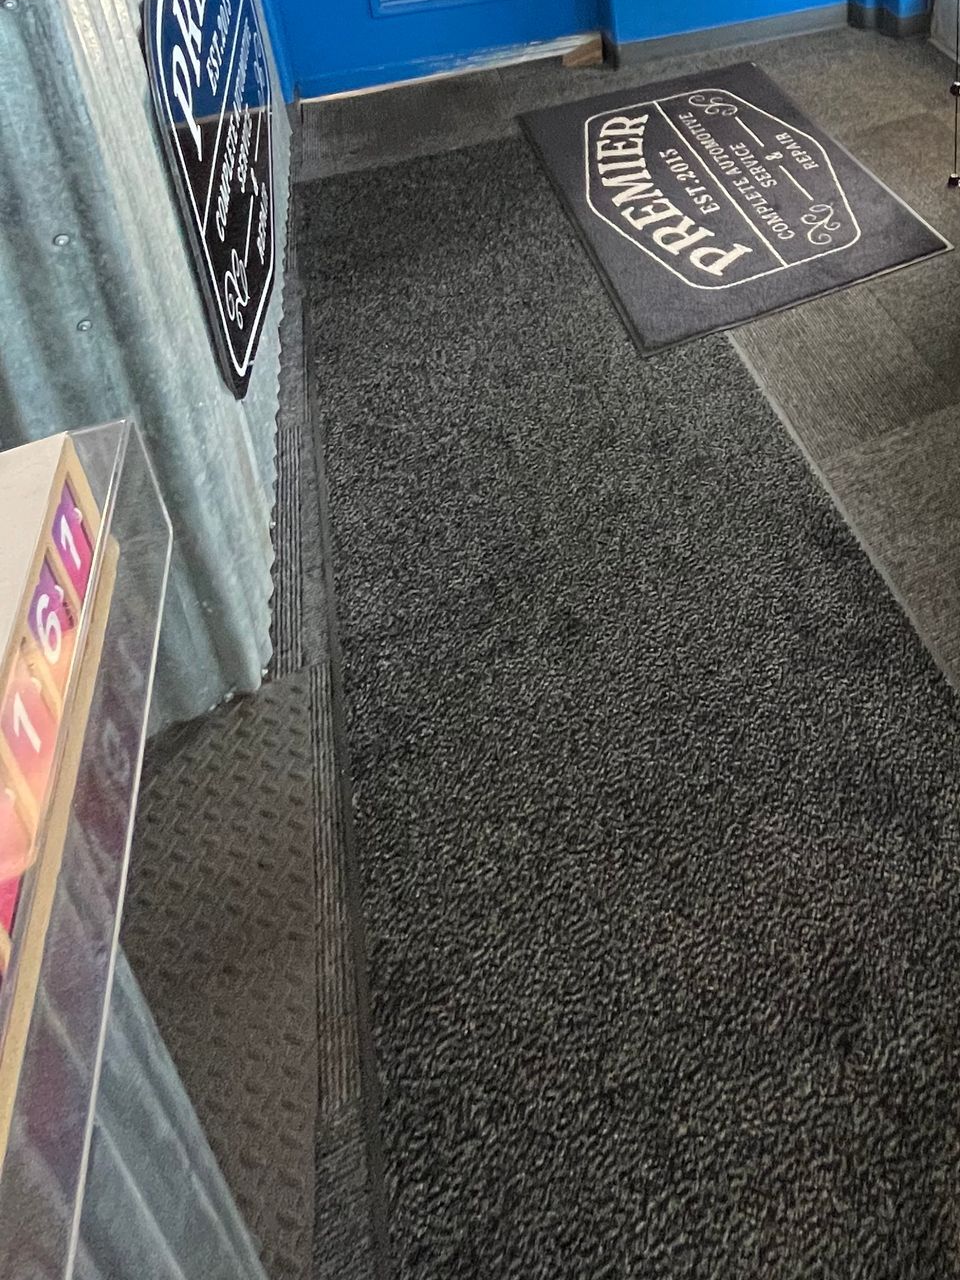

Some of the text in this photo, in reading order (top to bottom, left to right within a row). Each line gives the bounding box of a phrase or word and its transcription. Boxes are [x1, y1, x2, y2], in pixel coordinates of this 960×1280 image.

[679, 111, 796, 240] COMPLETE AUTOMOTIVE
[729, 142, 778, 188] SERVICE
[775, 132, 820, 170] REPAIR
[596, 114, 753, 276] PREMIER
